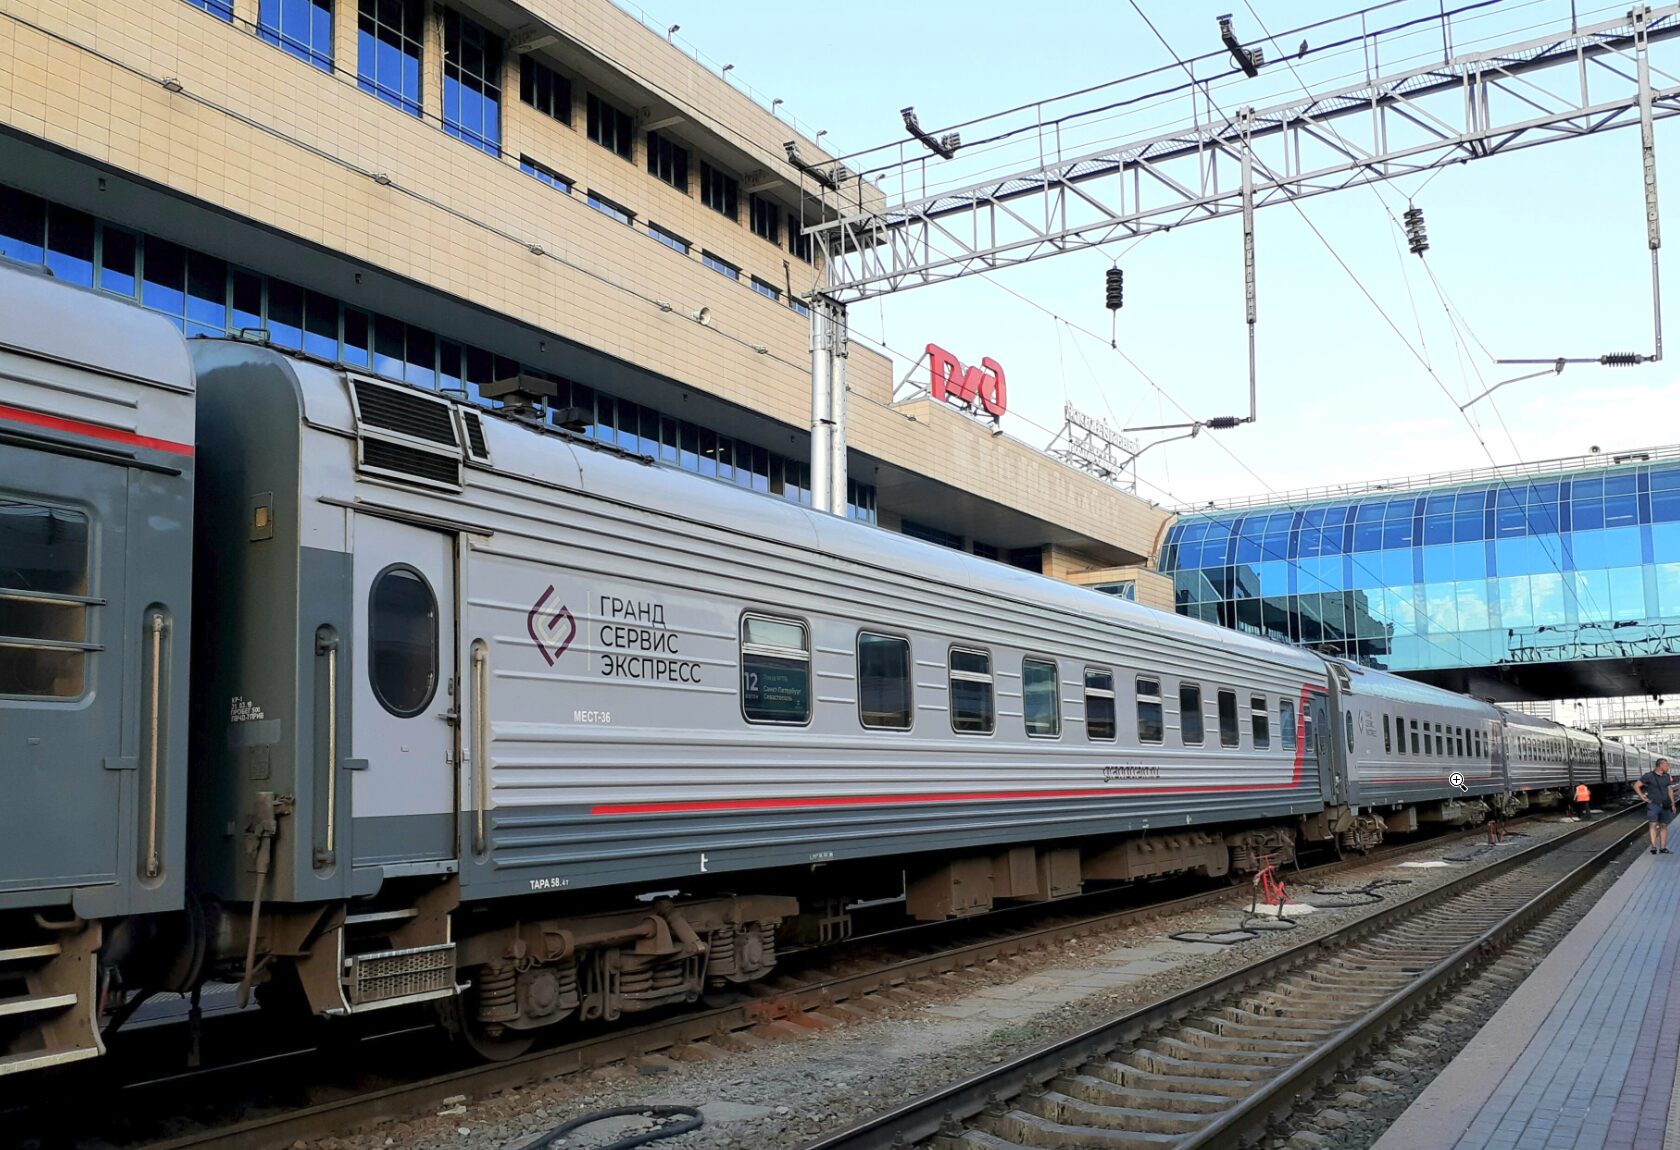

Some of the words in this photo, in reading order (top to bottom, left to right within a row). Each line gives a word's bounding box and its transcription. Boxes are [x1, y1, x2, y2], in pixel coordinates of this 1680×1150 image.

[600, 595, 666, 630] ГРАНД
[600, 625, 679, 654] СЕРВИС
[600, 654, 702, 683] ЭКСПРЕСС
[573, 710, 611, 723] МЕСТ-36
[529, 878, 550, 890] ТАРА
